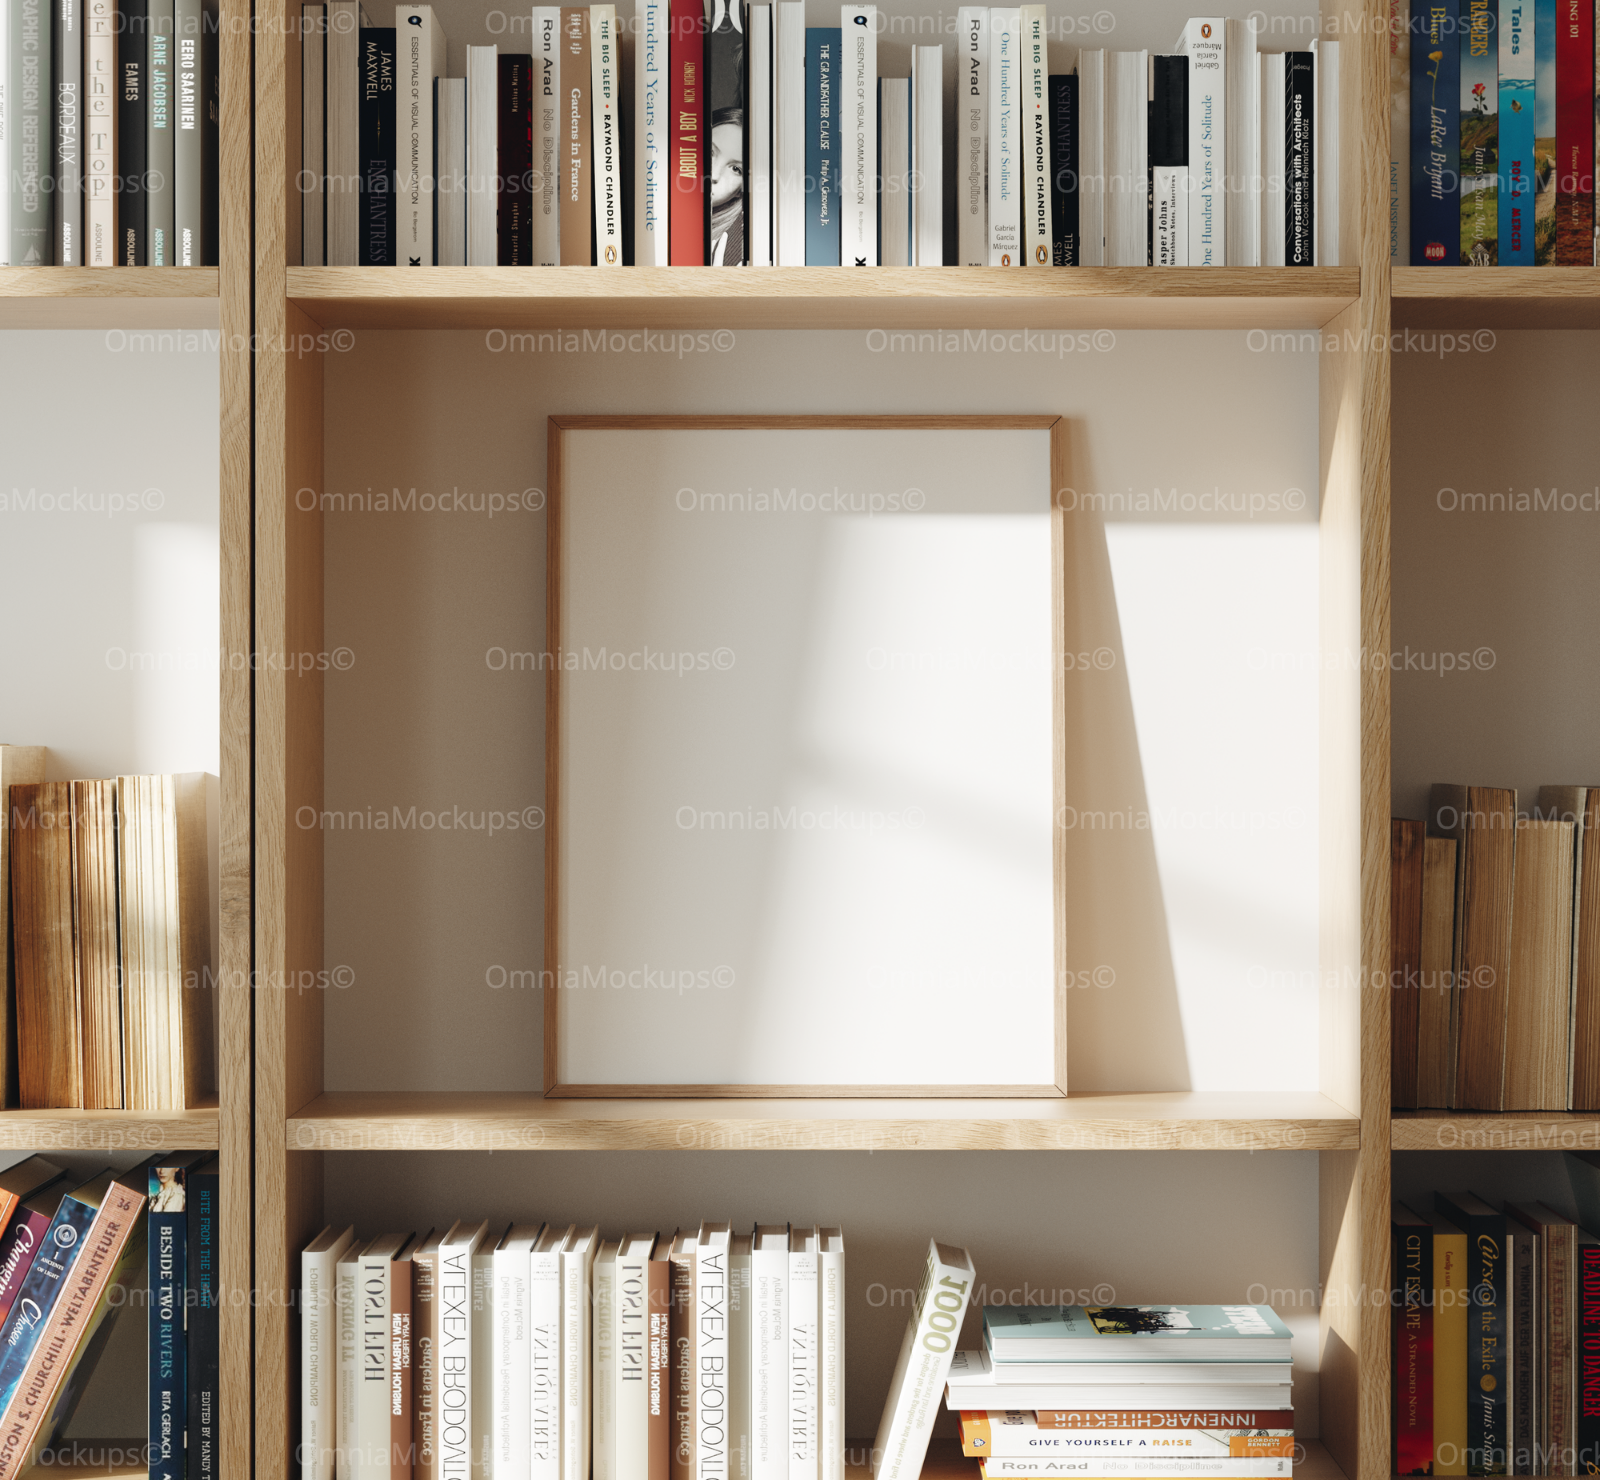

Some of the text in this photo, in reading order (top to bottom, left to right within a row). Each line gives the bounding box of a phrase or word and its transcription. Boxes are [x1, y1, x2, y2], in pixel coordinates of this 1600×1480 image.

[819, 44, 830, 60] THE
[1430, 6, 1446, 45] Blues
[1511, 6, 1522, 55] Tales
[22, 56, 39, 111] DESIGN
[92, 58, 106, 112] the
[125, 63, 138, 101] EAMES
[153, 35, 167, 128] ARNE JACOBSEN
[181, 39, 195, 130] EERO SAARINEN
[366, 41, 378, 100] MAXWELL
[380, 51, 392, 91] JAMES
[683, 61, 696, 85] HORNBY
[683, 88, 696, 103] NICK
[819, 61, 830, 118] GRANDFATHER
[58, 82, 75, 165] BORDEAUX
[411, 36, 419, 205] ESSENTIALS OF VISUAL COMMUNICATION
[541, 19, 554, 215] Ron Arad No Discipline
[601, 20, 615, 235] THE BIG SLEEP RAYMOND CHANDLER
[646, 79, 658, 126] Years
[679, 111, 697, 131] BOY
[857, 36, 865, 205] ESSENTIALS OF VISUAL COMMUNICATION
[968, 19, 981, 215] Ron Arad No Discipline
[1000, 32, 1011, 201] One Hundred Years of Solitude
[1032, 20, 1046, 235] THE BIG SLEEP RAYMOND CHANDLER
[1201, 95, 1213, 141] Solitude
[571, 88, 581, 202] Gardens in France
[646, 132, 658, 153] of
[1056, 85, 1071, 179] ENCHANTRESS
[1201, 144, 1213, 157] of
[22, 115, 39, 213] REFERENCED
[91, 132, 107, 197] Top
[679, 147, 697, 179] ABOUT
[1201, 161, 1213, 191] Years
[1293, 94, 1303, 263] Conversations with Architects
[1423, 150, 1446, 200] Bryant
[1471, 144, 1486, 240] Janis Susan May
[369, 159, 387, 262] ENCHANTRESS
[645, 160, 658, 231] Solitude
[1201, 194, 1213, 244] Hundred
[1511, 160, 1521, 252] ROY D. MERCER
[63, 222, 72, 262] ASSOULINE
[127, 228, 136, 267] ASSOULINE
[154, 228, 163, 267] ASSOULINE
[182, 228, 192, 267] ASSOULINE
[994, 224, 1016, 232] Gabriel
[200, 1190, 211, 1309] BITE FROM THE HEART
[160, 1225, 173, 1378] BESIDE TWO RIVERS
[1405, 1235, 1420, 1329] CITY ESCAPE
[1476, 1234, 1500, 1371] Curse of the Exile
[6, 1298, 42, 1347] Chosen
[23, 1221, 121, 1406] CHURCHILL WELTABENTEUER
[1582, 1249, 1600, 1417] DEADLINE TO DANGER
[161, 1391, 172, 1458] RITA GERLACH
[201, 1391, 211, 1473] EDITED BY MANDY
[1029, 1438, 1193, 1447] GIVE YOURSELF A RAISE
[1054, 1413, 1257, 1427] INNENARCHITEKTUR
[1001, 1462, 1089, 1471] Ron Arad
